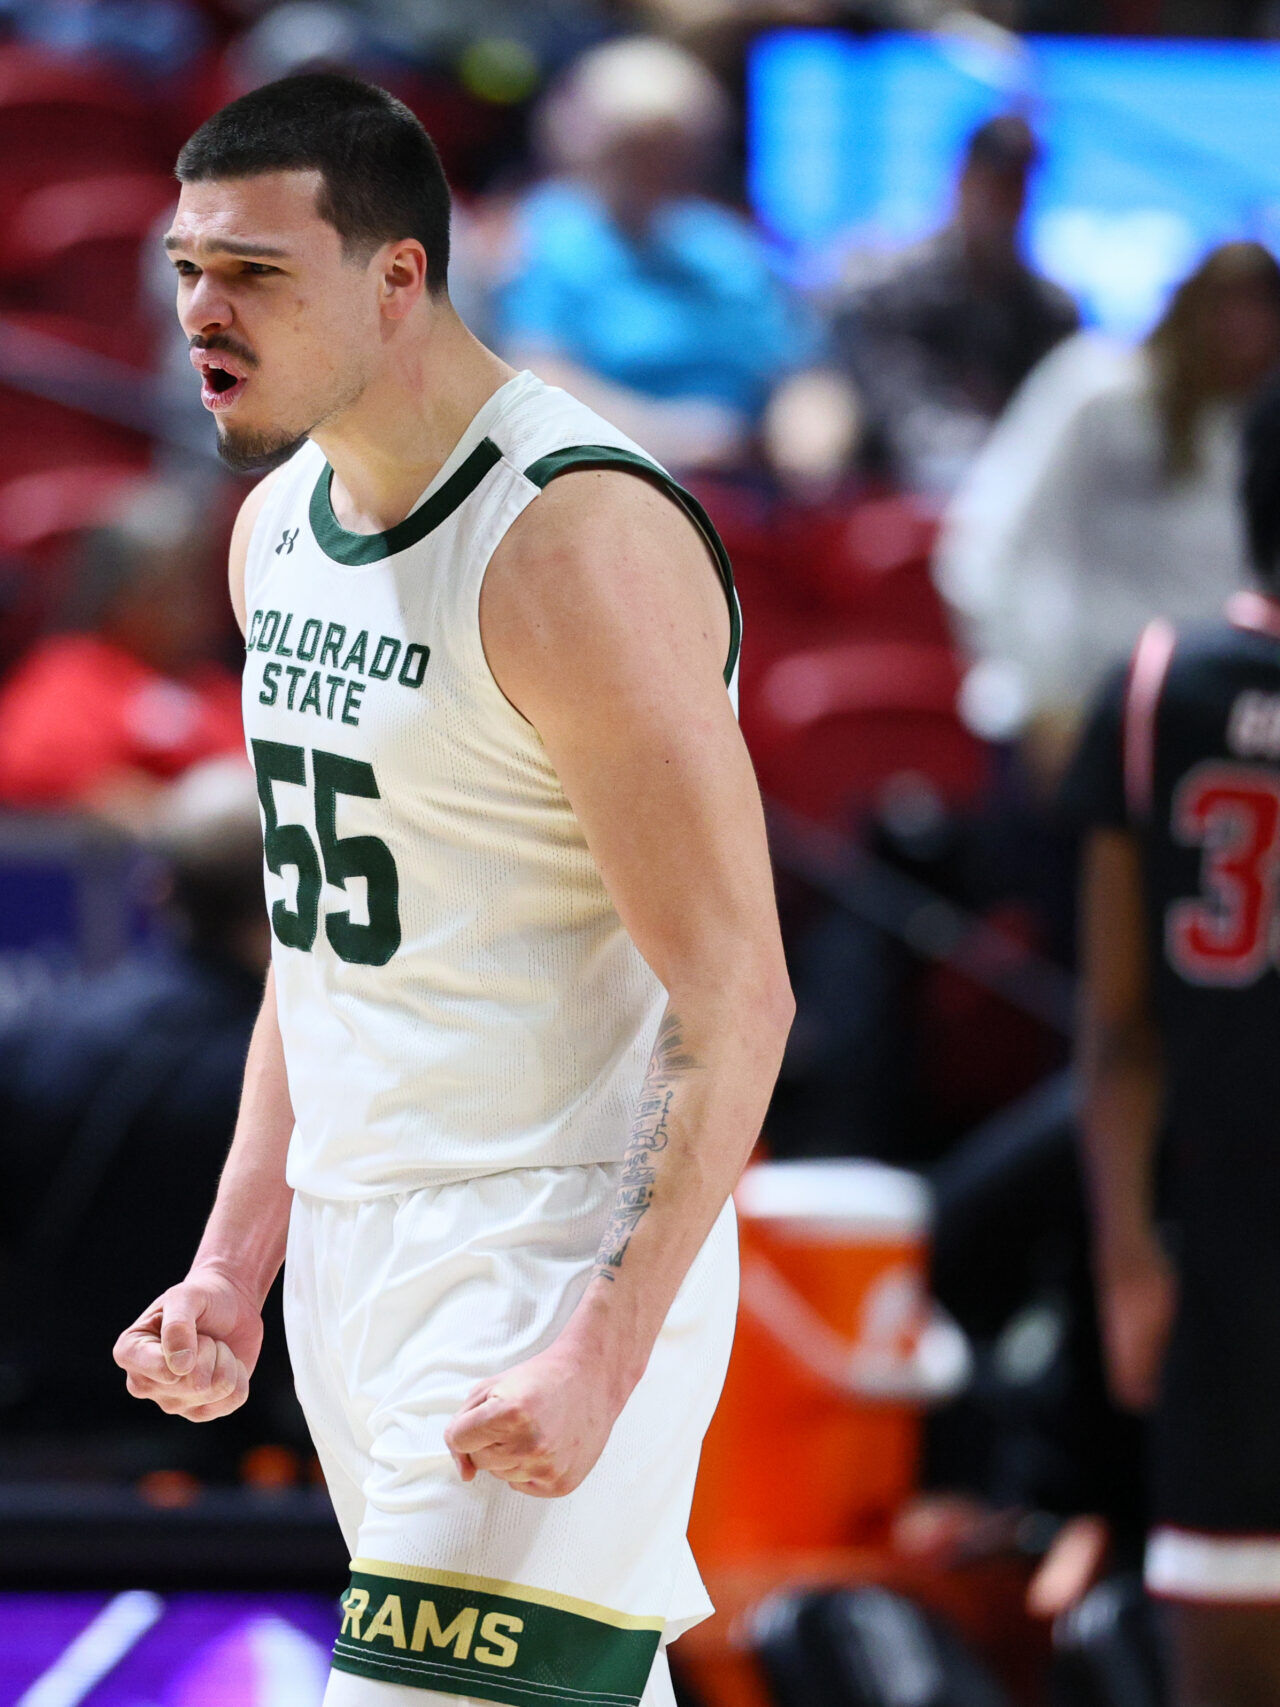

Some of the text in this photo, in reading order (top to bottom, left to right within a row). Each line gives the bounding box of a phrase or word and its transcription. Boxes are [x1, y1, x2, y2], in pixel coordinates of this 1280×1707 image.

[245, 609, 431, 689] COLORADO
[258, 661, 367, 727] STATE
[251, 737, 402, 967] 55
[1165, 758, 1280, 989] 3
[340, 1587, 524, 1668] RAMS
